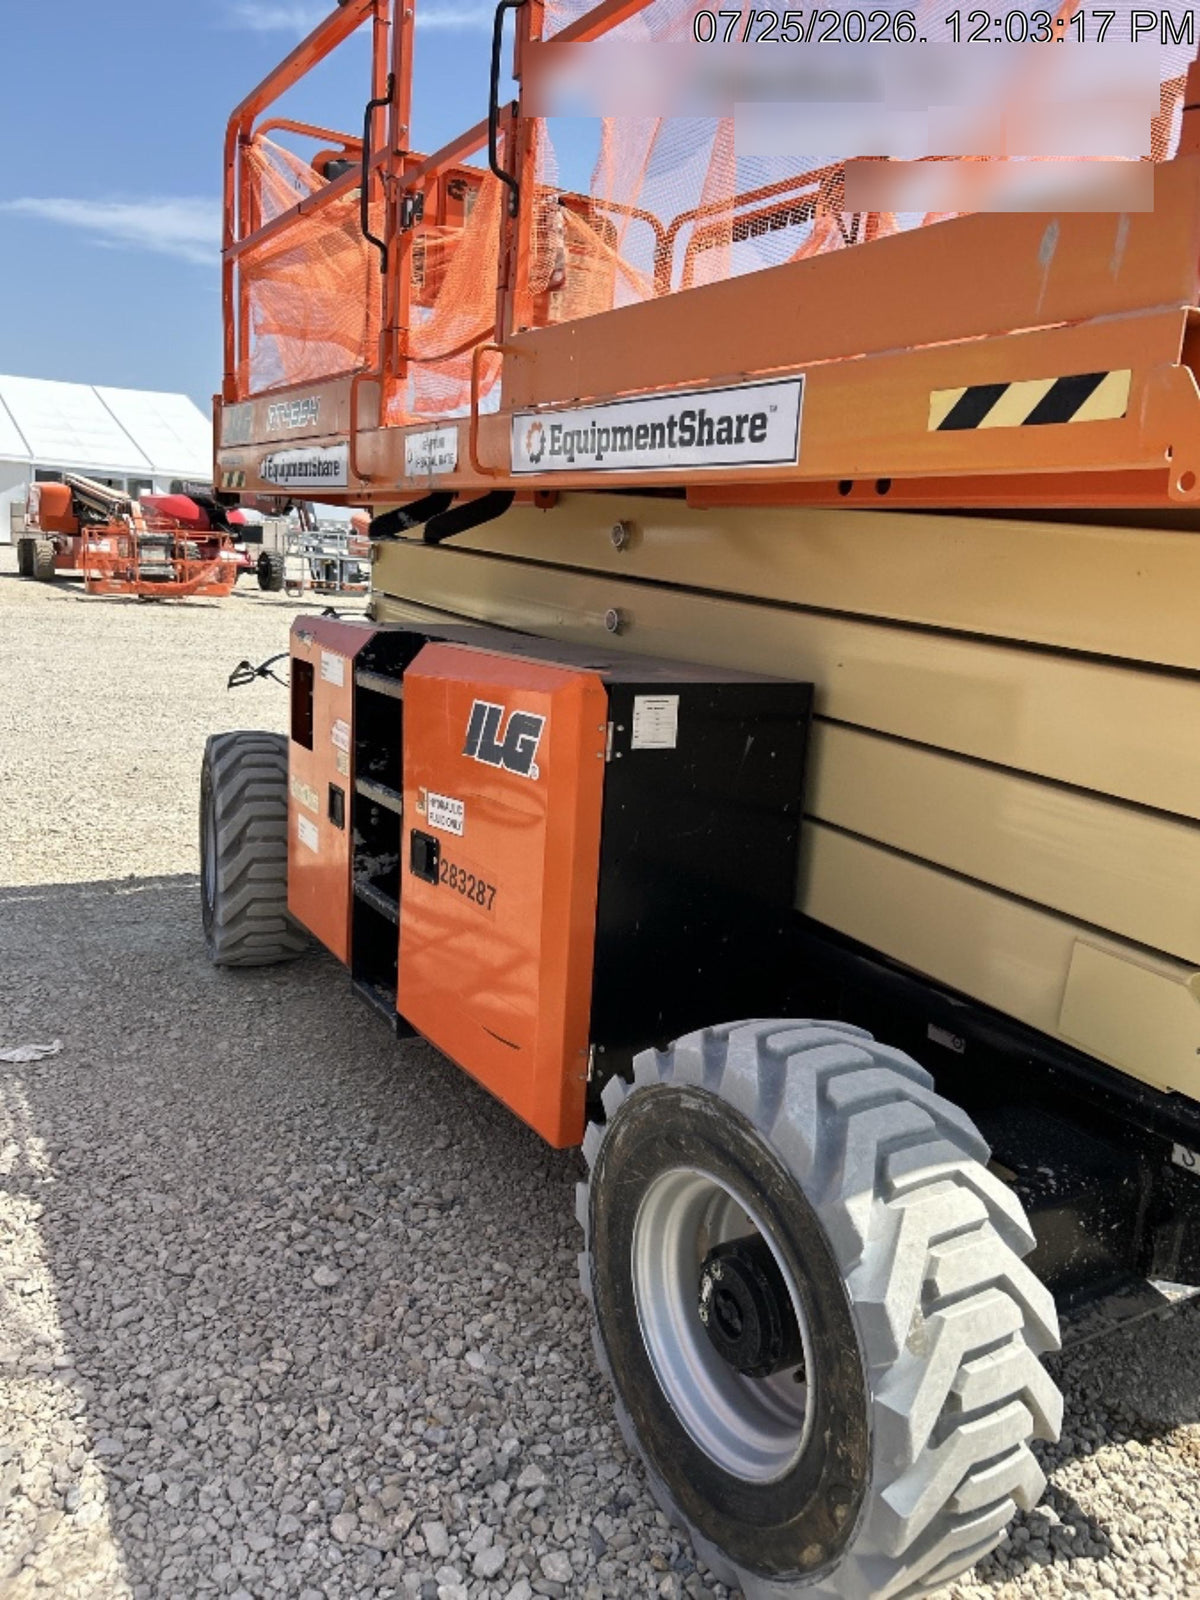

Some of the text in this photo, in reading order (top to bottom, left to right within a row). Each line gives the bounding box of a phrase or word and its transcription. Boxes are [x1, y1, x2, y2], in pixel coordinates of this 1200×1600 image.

[548, 408, 768, 463] EquipmentShare
[461, 698, 546, 778] JLG
[439, 858, 497, 911] 283287
